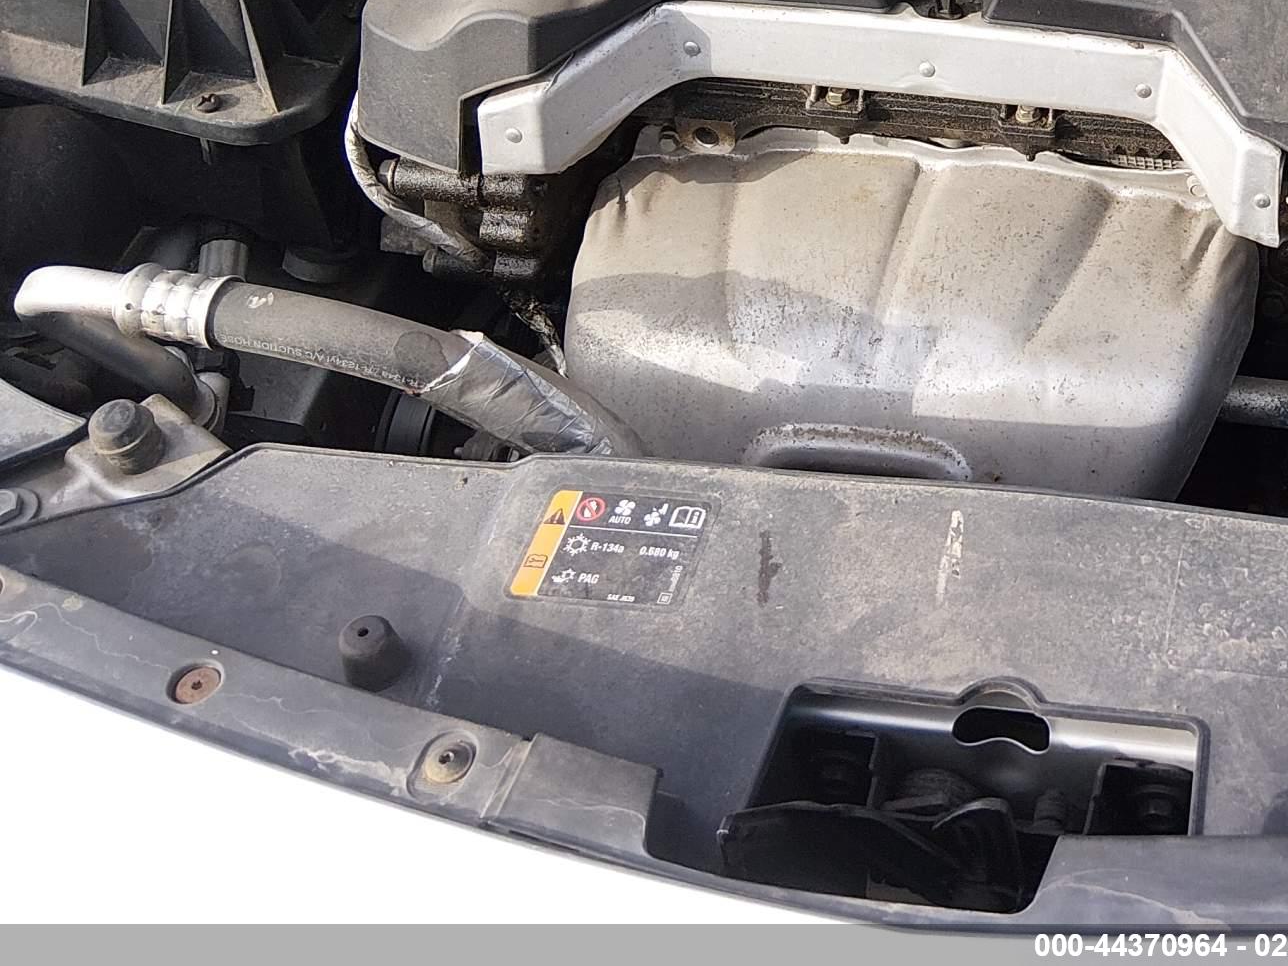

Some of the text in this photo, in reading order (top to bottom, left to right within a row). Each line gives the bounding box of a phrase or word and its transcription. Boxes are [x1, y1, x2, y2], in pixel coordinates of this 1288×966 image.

[219, 334, 251, 347] HOSE
[253, 340, 303, 357] SUCTION
[304, 350, 326, 363] A/C
[608, 515, 631, 525] AUTO
[590, 542, 625, 554] R-134a
[666, 548, 680, 561] kg
[577, 573, 600, 584] PAG
